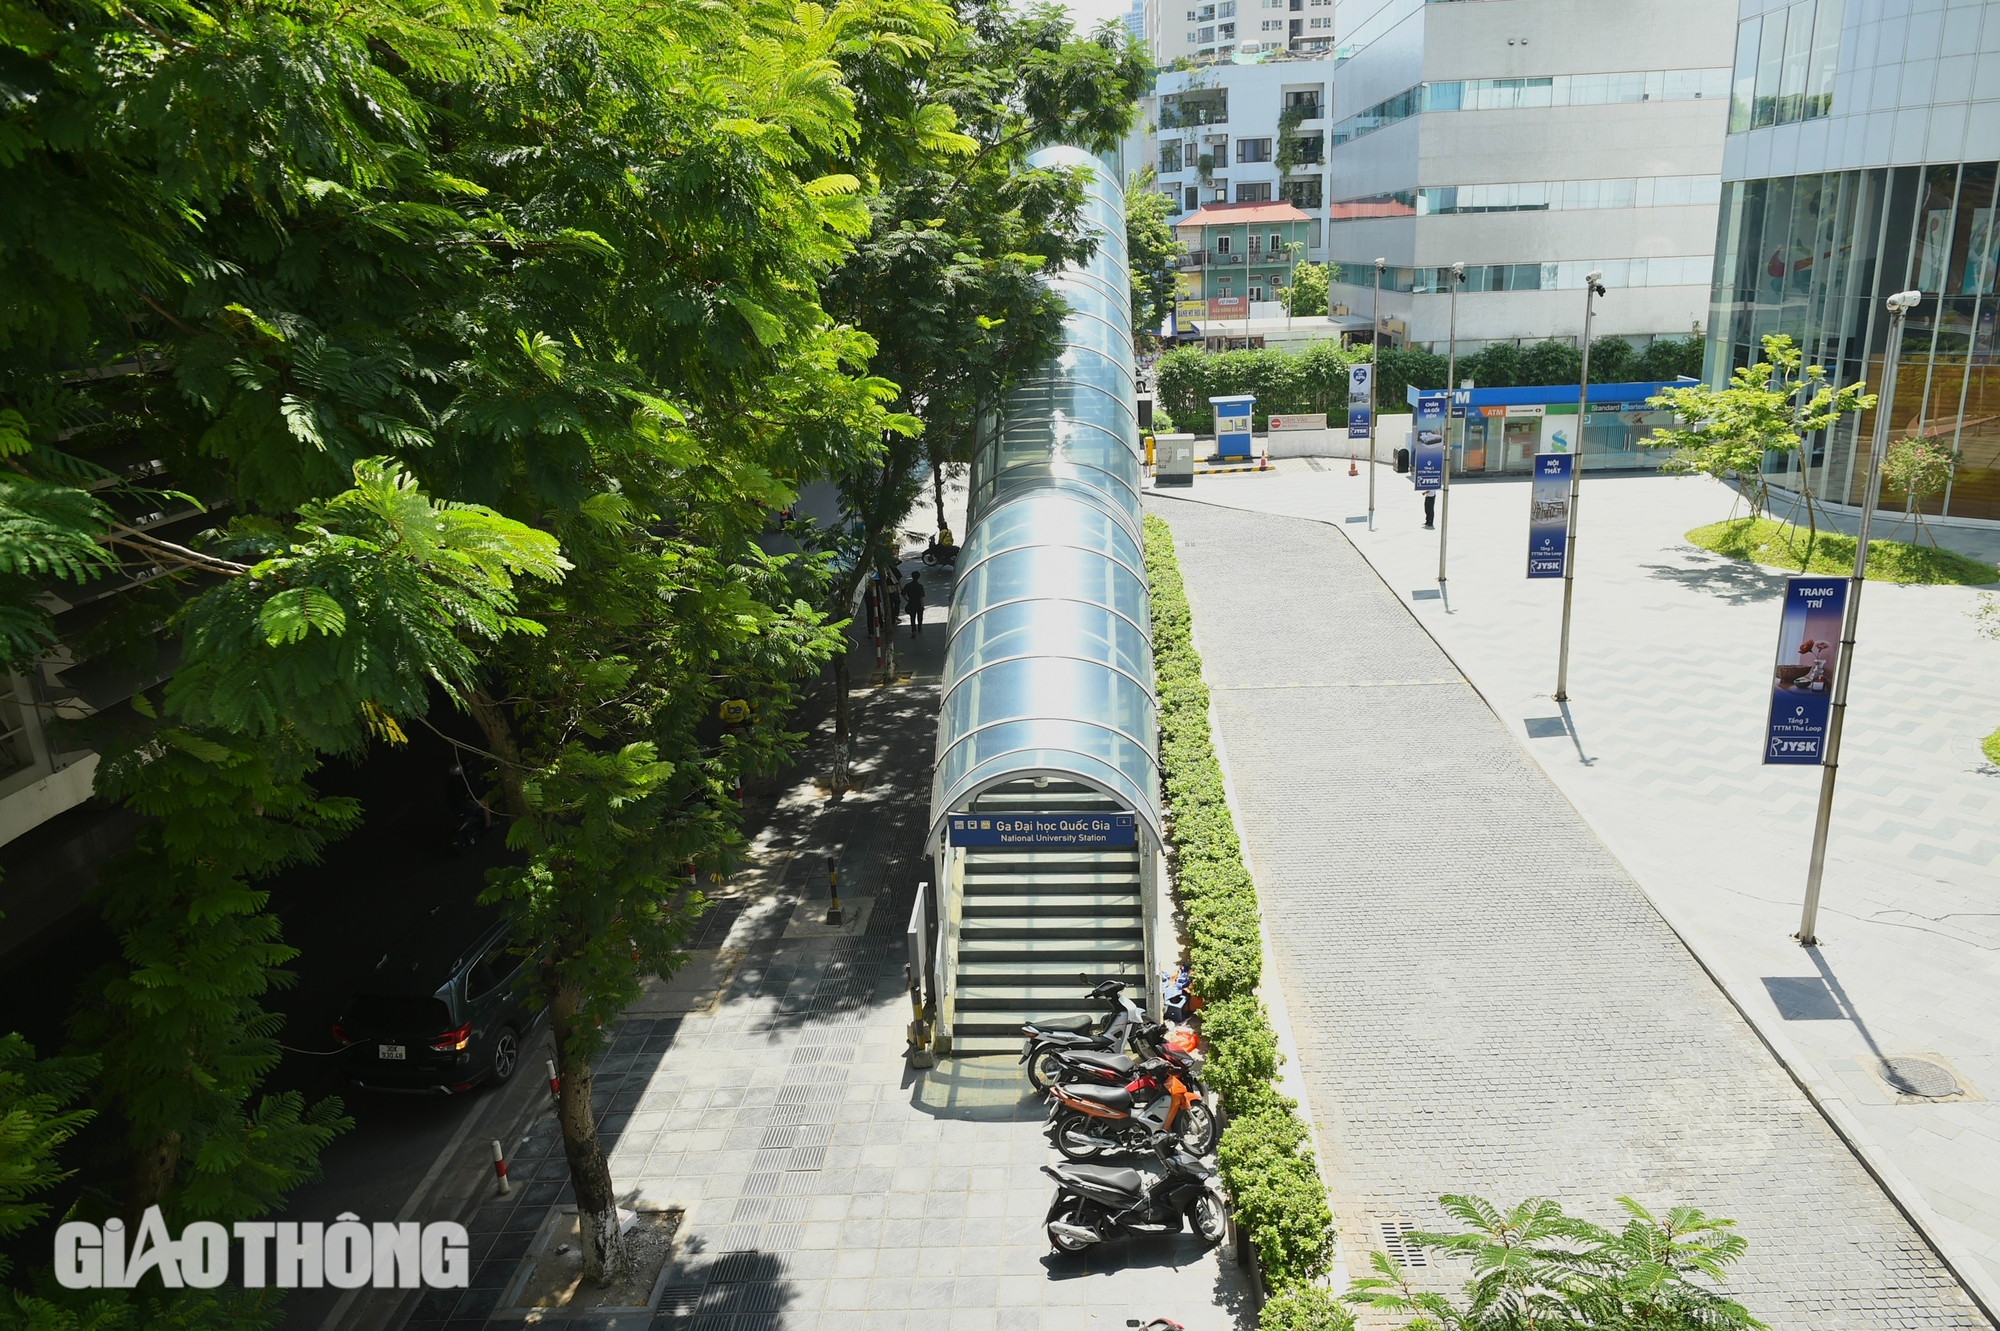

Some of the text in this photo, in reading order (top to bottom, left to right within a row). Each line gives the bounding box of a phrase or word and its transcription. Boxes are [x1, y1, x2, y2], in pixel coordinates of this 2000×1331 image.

[1591, 404, 1620, 412] Standard
[1798, 588, 1834, 596] TRANG
[1806, 598, 1823, 608] TRÍ
[1804, 725, 1822, 733] Loop
[1780, 741, 1816, 752] JYSK
[996, 818, 1111, 835] Ga Đại học Quốc Gia
[1001, 834, 1107, 844] National University Station
